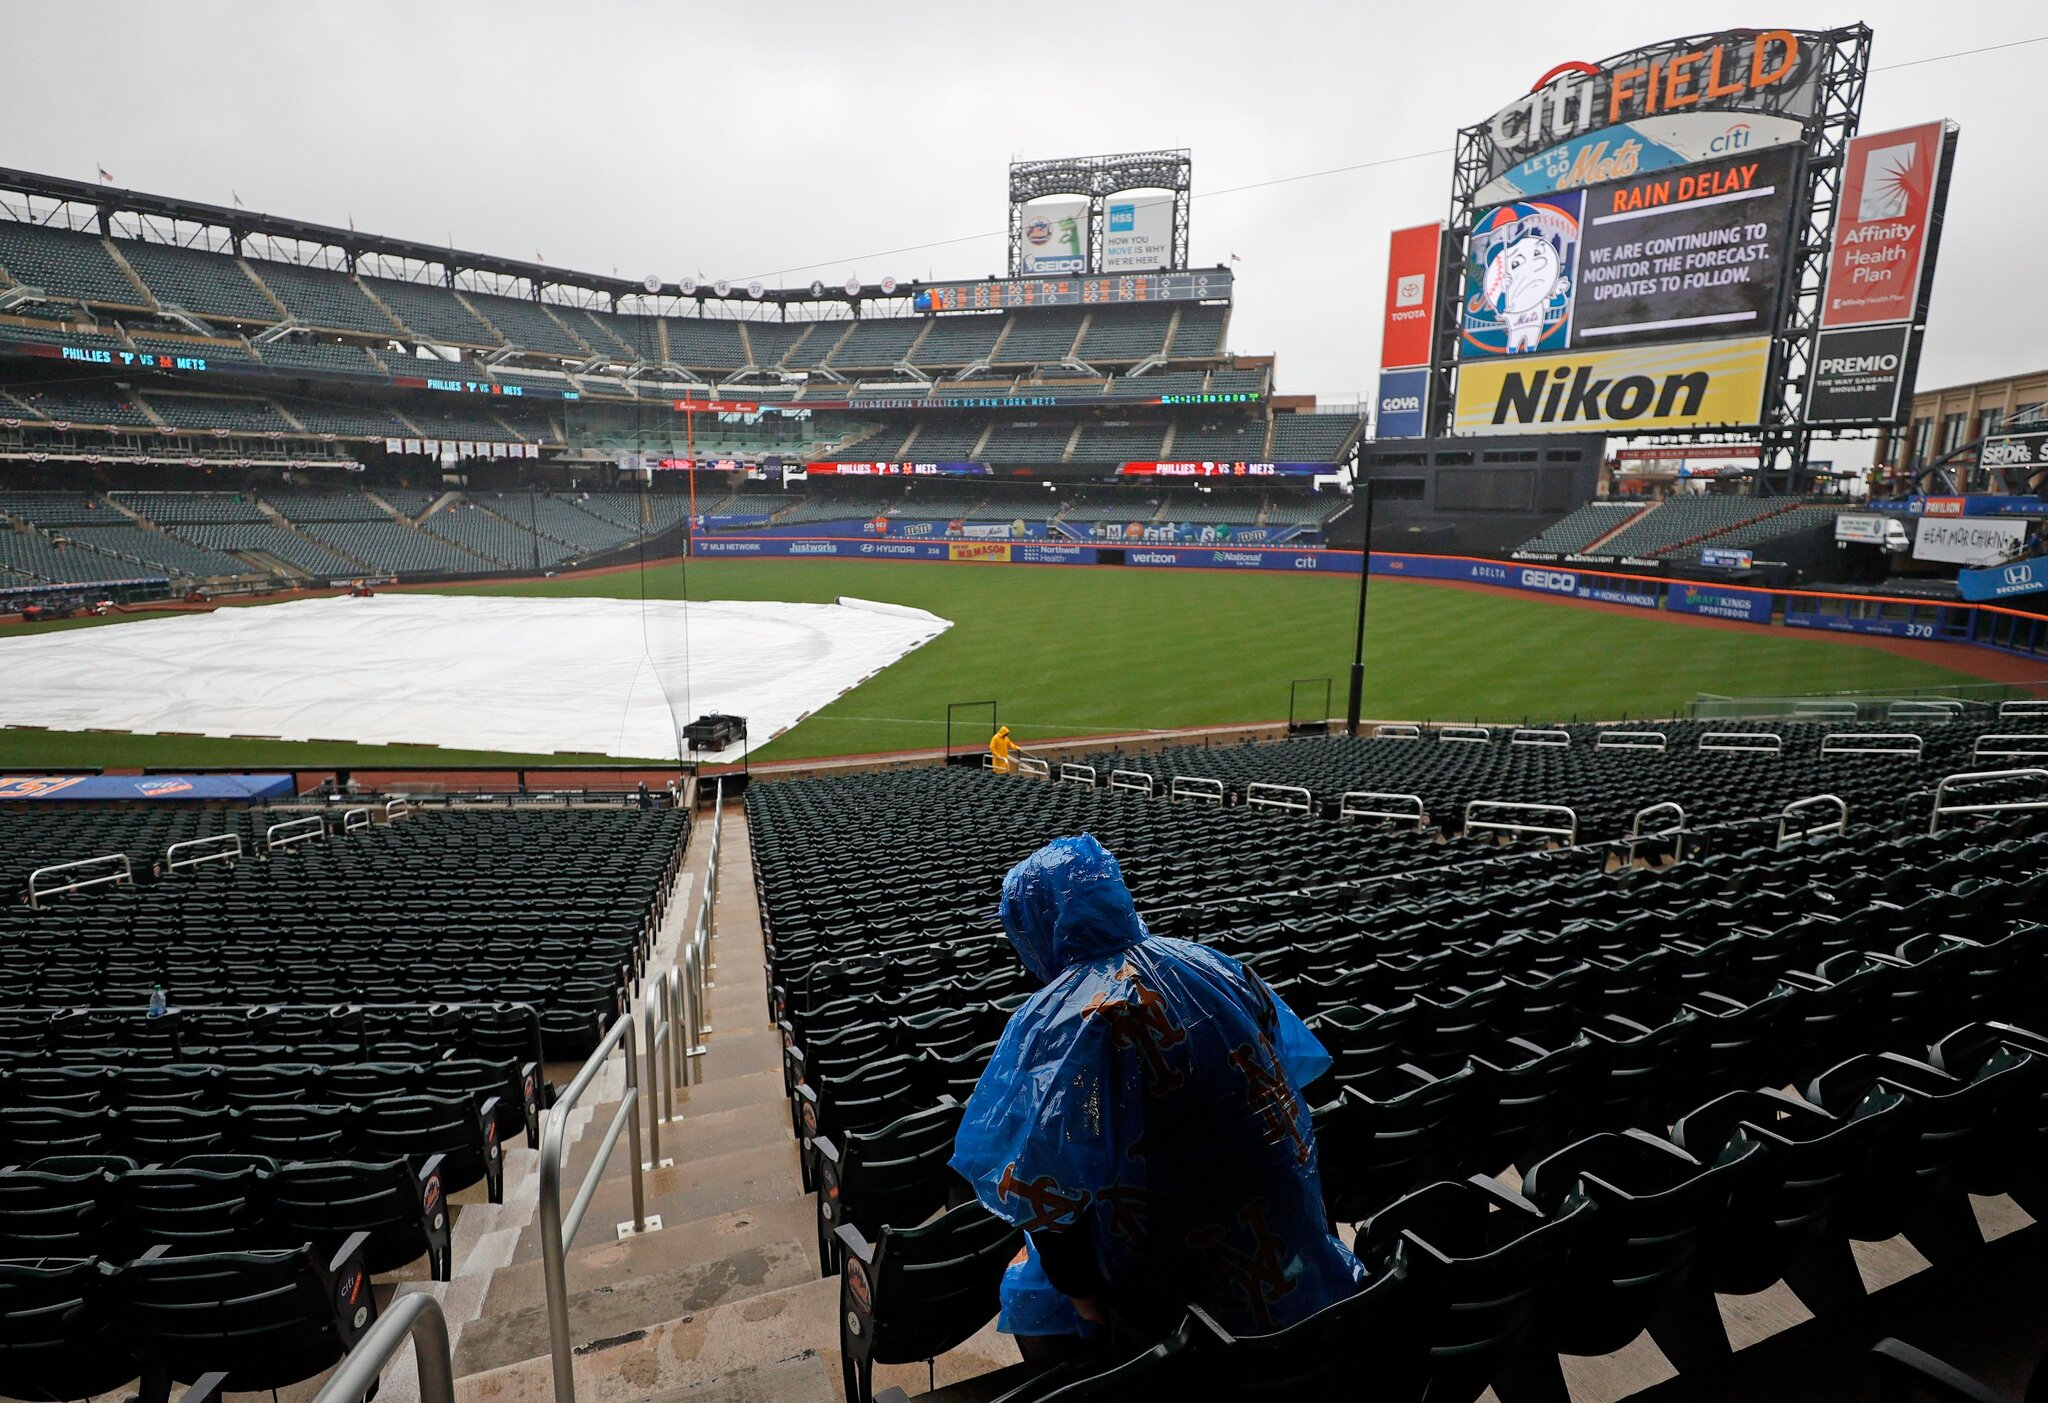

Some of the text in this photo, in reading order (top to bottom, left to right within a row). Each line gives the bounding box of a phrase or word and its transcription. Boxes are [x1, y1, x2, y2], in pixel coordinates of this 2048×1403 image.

[1492, 30, 1799, 148] citi FIELD
[1710, 125, 1750, 153] citi
[1523, 146, 1569, 176] LET'S
[1555, 138, 1644, 190] Mets
[1547, 158, 1571, 178] GO
[1612, 163, 1759, 213] RAIN DELAY
[1111, 213, 1133, 224] HSS
[1843, 222, 1916, 246] Affinity
[1108, 236, 1149, 246] HOW YOU
[1589, 222, 1768, 265] WE ARE CONTINUING TO
[1108, 244, 1166, 256] MOVE IS WHY
[1844, 244, 1907, 267] Health
[1034, 259, 1084, 273] GEICO
[1108, 256, 1161, 266] WE'RE HERE.
[1583, 243, 1770, 284] MONITOR THE FORECAST.
[1852, 267, 1892, 285] Plan
[683, 281, 694, 290] 41
[717, 282, 727, 291] 14
[751, 285, 761, 294] 37
[883, 280, 893, 289] 42
[1594, 266, 1751, 301] UPDATES TO FOLLOW.
[1391, 310, 1425, 321] TOYOTA
[62, 347, 112, 363] PHILLIES
[139, 355, 155, 366] VS
[177, 357, 207, 371] METS
[1818, 354, 1898, 375] PREMIO
[427, 379, 462, 392] PHILLIES
[502, 385, 523, 396] METS
[1817, 375, 1895, 387] THE WAY SAUSAGE
[1491, 366, 1710, 425] Nikon
[849, 397, 1057, 408] PHILADELPHIA PHILLIES VS NEW YORK METS
[1382, 396, 1420, 411] GOYA
[837, 463, 871, 474] PHILLIES
[889, 463, 900, 473] VS
[915, 463, 938, 474] METS
[1156, 463, 1196, 475] PHILLIES
[1218, 463, 1230, 474] VS
[1249, 463, 1276, 475] METS
[1925, 502, 1961, 513] PAVILION
[1923, 527, 1948, 545] #EAT
[1947, 527, 1968, 547] MOR
[709, 543, 761, 551] MLB NETWORK
[789, 542, 837, 552] Justworks
[876, 545, 915, 554] HYUNDAI
[1040, 545, 1080, 555] Northwell
[1040, 554, 1066, 563] Health
[1132, 552, 1176, 564] verizon
[1224, 552, 1262, 562] National
[1295, 556, 1316, 569] citi
[1480, 566, 1506, 579] DELTA
[1521, 569, 1576, 592] GEICO
[1996, 581, 2044, 594] HONDA
[1601, 591, 1656, 608] KONICA MINOLTA
[1699, 605, 1750, 619] SPORTSBOOK
[1905, 623, 1933, 638] 370
